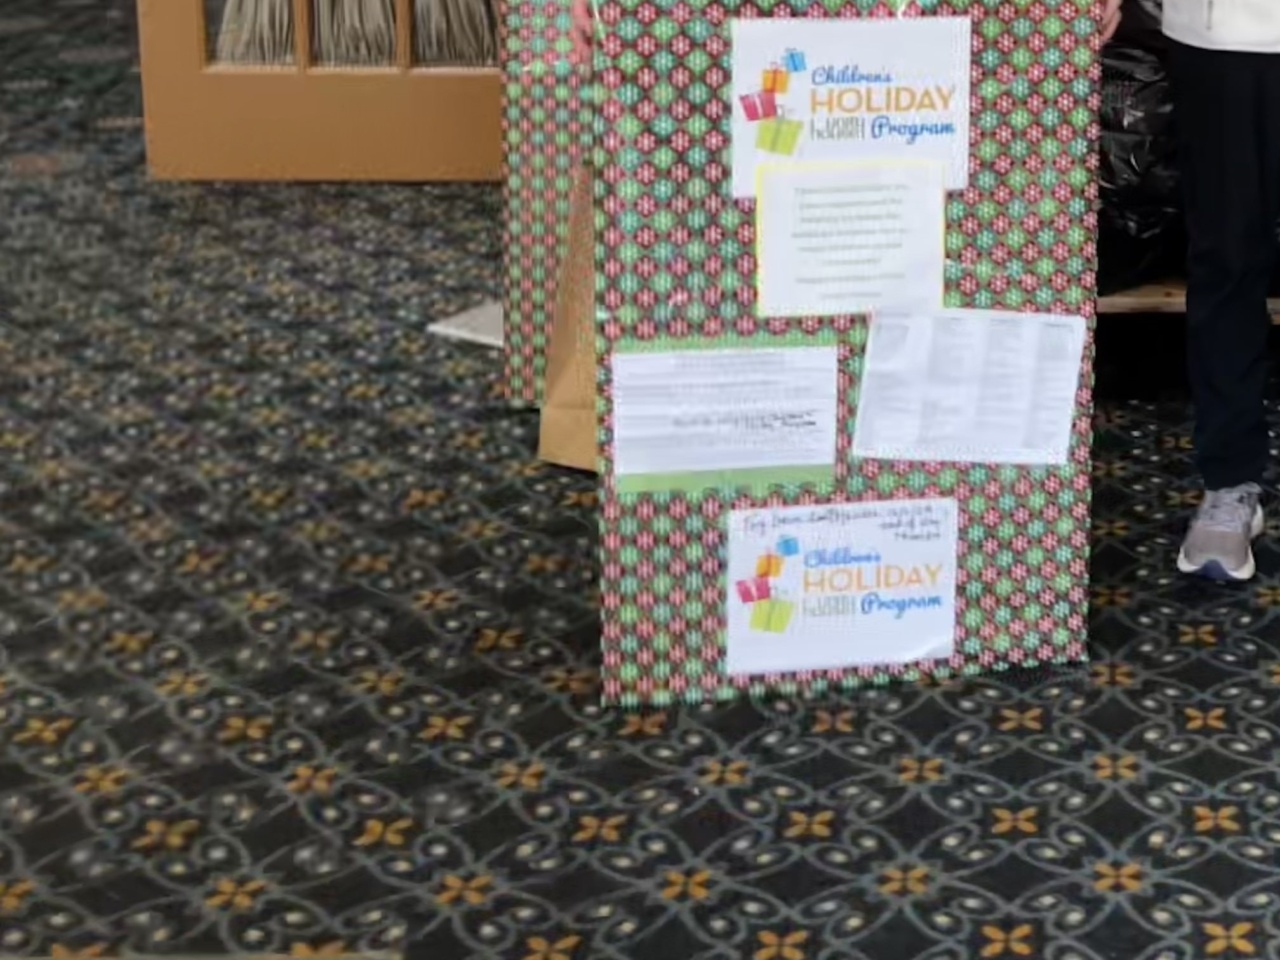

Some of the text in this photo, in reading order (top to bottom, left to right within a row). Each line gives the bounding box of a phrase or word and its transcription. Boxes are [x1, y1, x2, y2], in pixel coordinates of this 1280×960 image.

[810, 85, 956, 115] HOLIDAY
[870, 115, 956, 145] Program
[803, 562, 943, 593] HOLIDAY
[860, 591, 942, 620] Program
